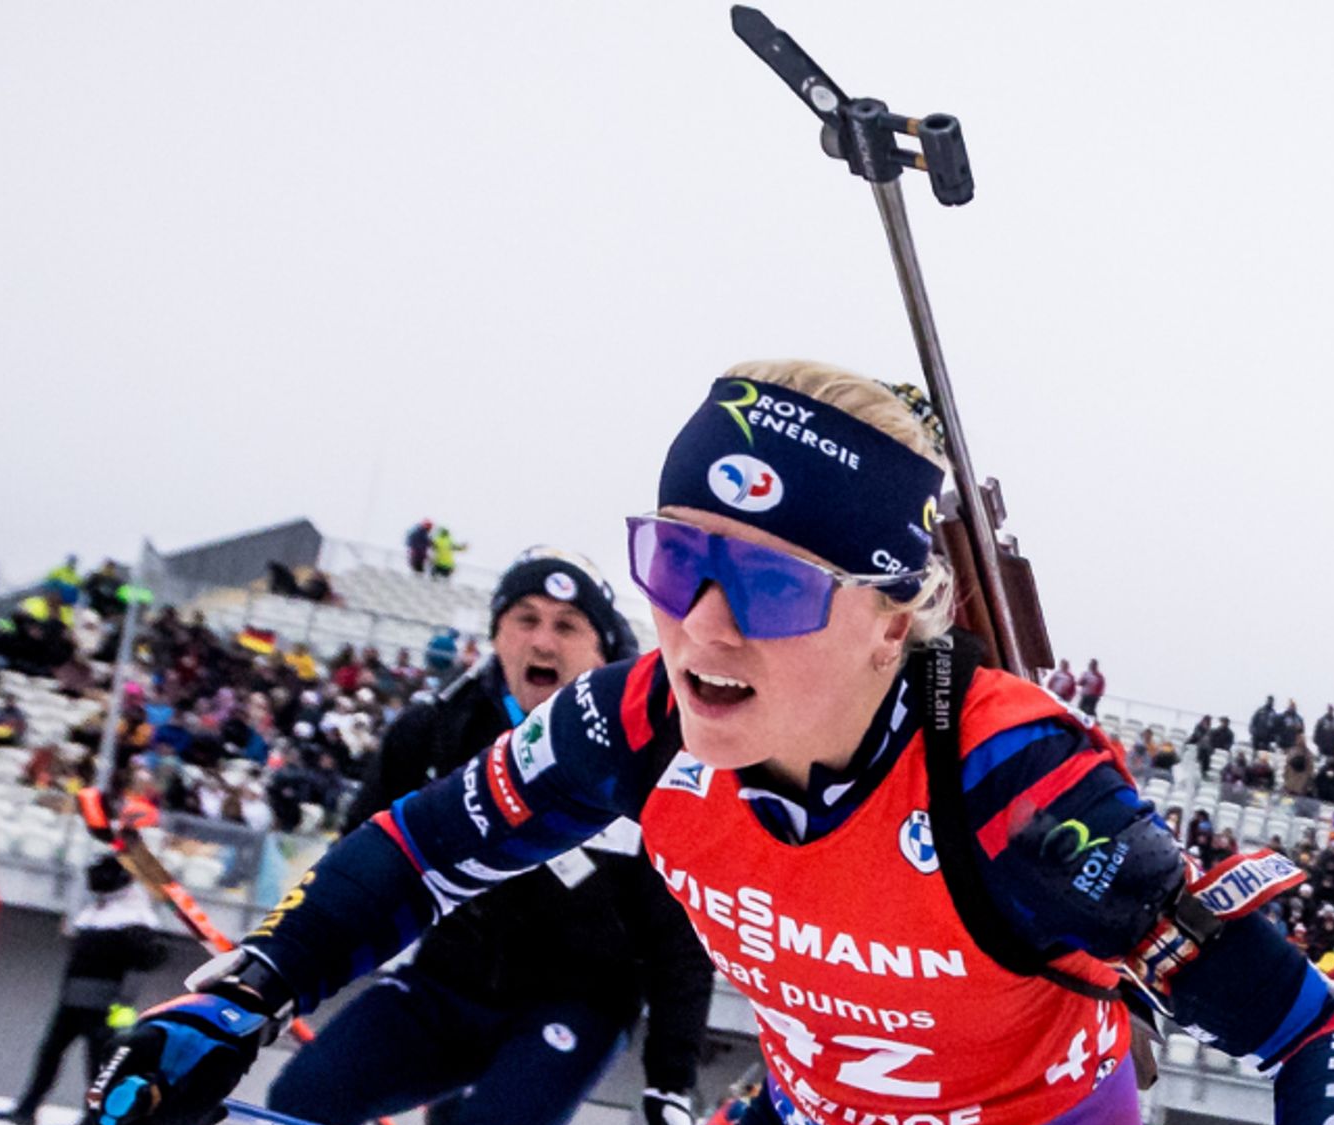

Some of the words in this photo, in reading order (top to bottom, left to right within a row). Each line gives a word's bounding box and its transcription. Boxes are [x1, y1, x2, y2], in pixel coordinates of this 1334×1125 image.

[756, 395, 814, 424] ROY
[748, 409, 861, 471] ENERGIE
[1073, 846, 1109, 893] ROY
[779, 981, 936, 1033] pumps
